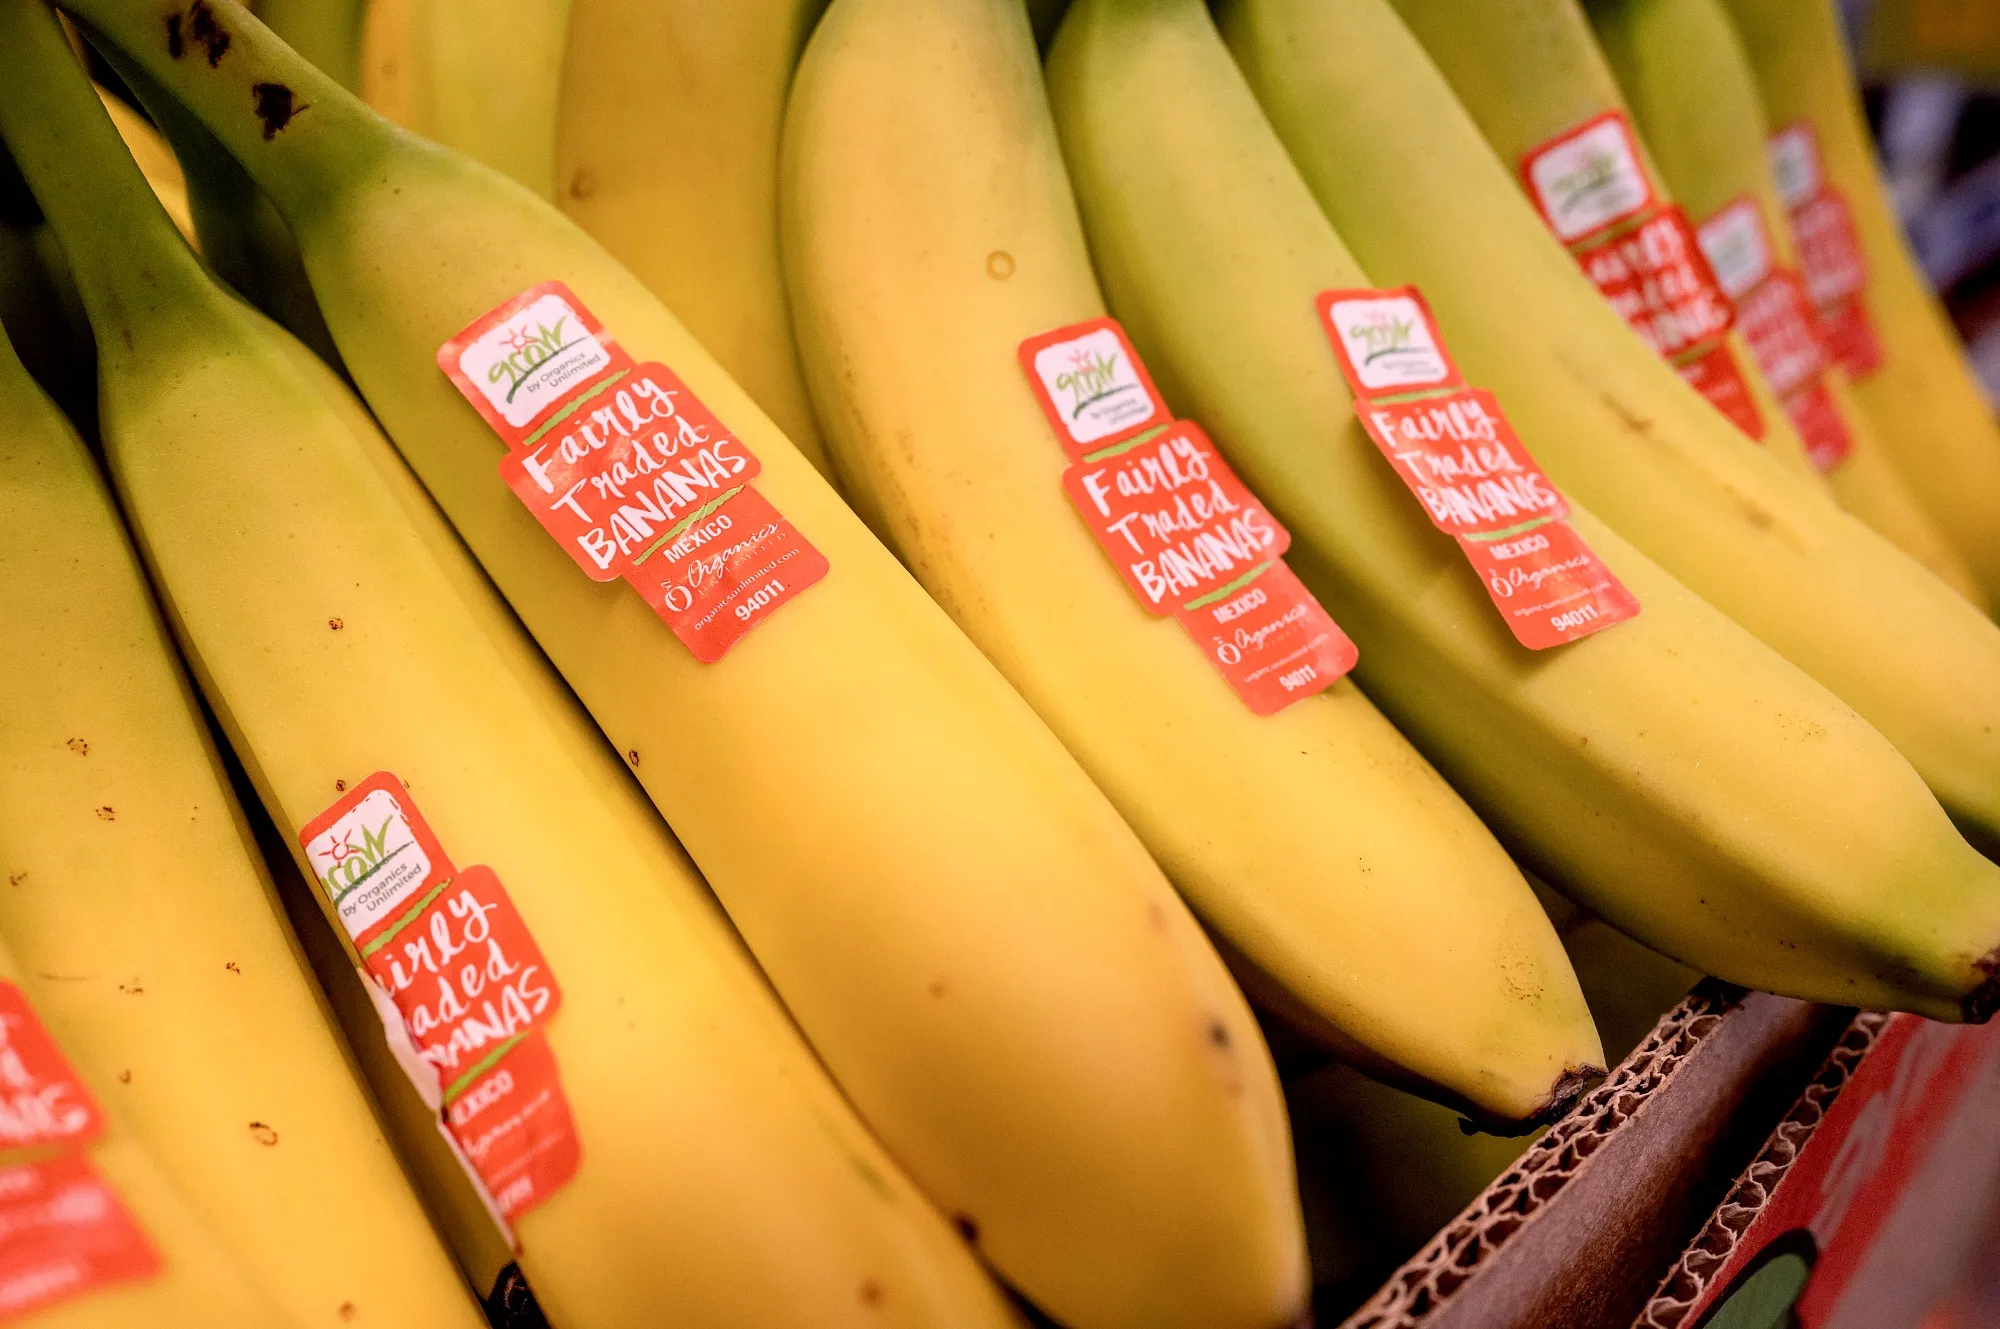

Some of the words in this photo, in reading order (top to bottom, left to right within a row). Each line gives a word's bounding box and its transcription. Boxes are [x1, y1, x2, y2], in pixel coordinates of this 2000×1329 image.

[527, 382, 541, 394] by
[540, 352, 586, 383] Organics
[549, 353, 600, 389] Unlimited
[521, 377, 678, 494] Fairly
[1370, 399, 1499, 448] Fairly
[550, 414, 710, 523] Traded
[1082, 435, 1210, 517] Fairly
[1394, 440, 1524, 485] Traded
[576, 440, 746, 570] BANANAS
[1106, 478, 1240, 555] Traded
[1419, 472, 1557, 526] BANANAS
[663, 514, 733, 564] MEXICO
[687, 523, 779, 588] Organics
[1131, 508, 1275, 603] BANANAS
[1489, 534, 1550, 561] MEXICO
[694, 548, 800, 631] organicsunlimitedcom
[735, 579, 785, 621] 94011
[1212, 587, 1268, 624] MEXICO
[1550, 604, 1599, 632] 94011
[1279, 664, 1317, 691] 94011
[342, 904, 357, 918] by
[357, 862, 407, 905] Organics
[367, 863, 422, 912] Unlimited
[377, 889, 498, 997] irly
[412, 937, 519, 1036] aded
